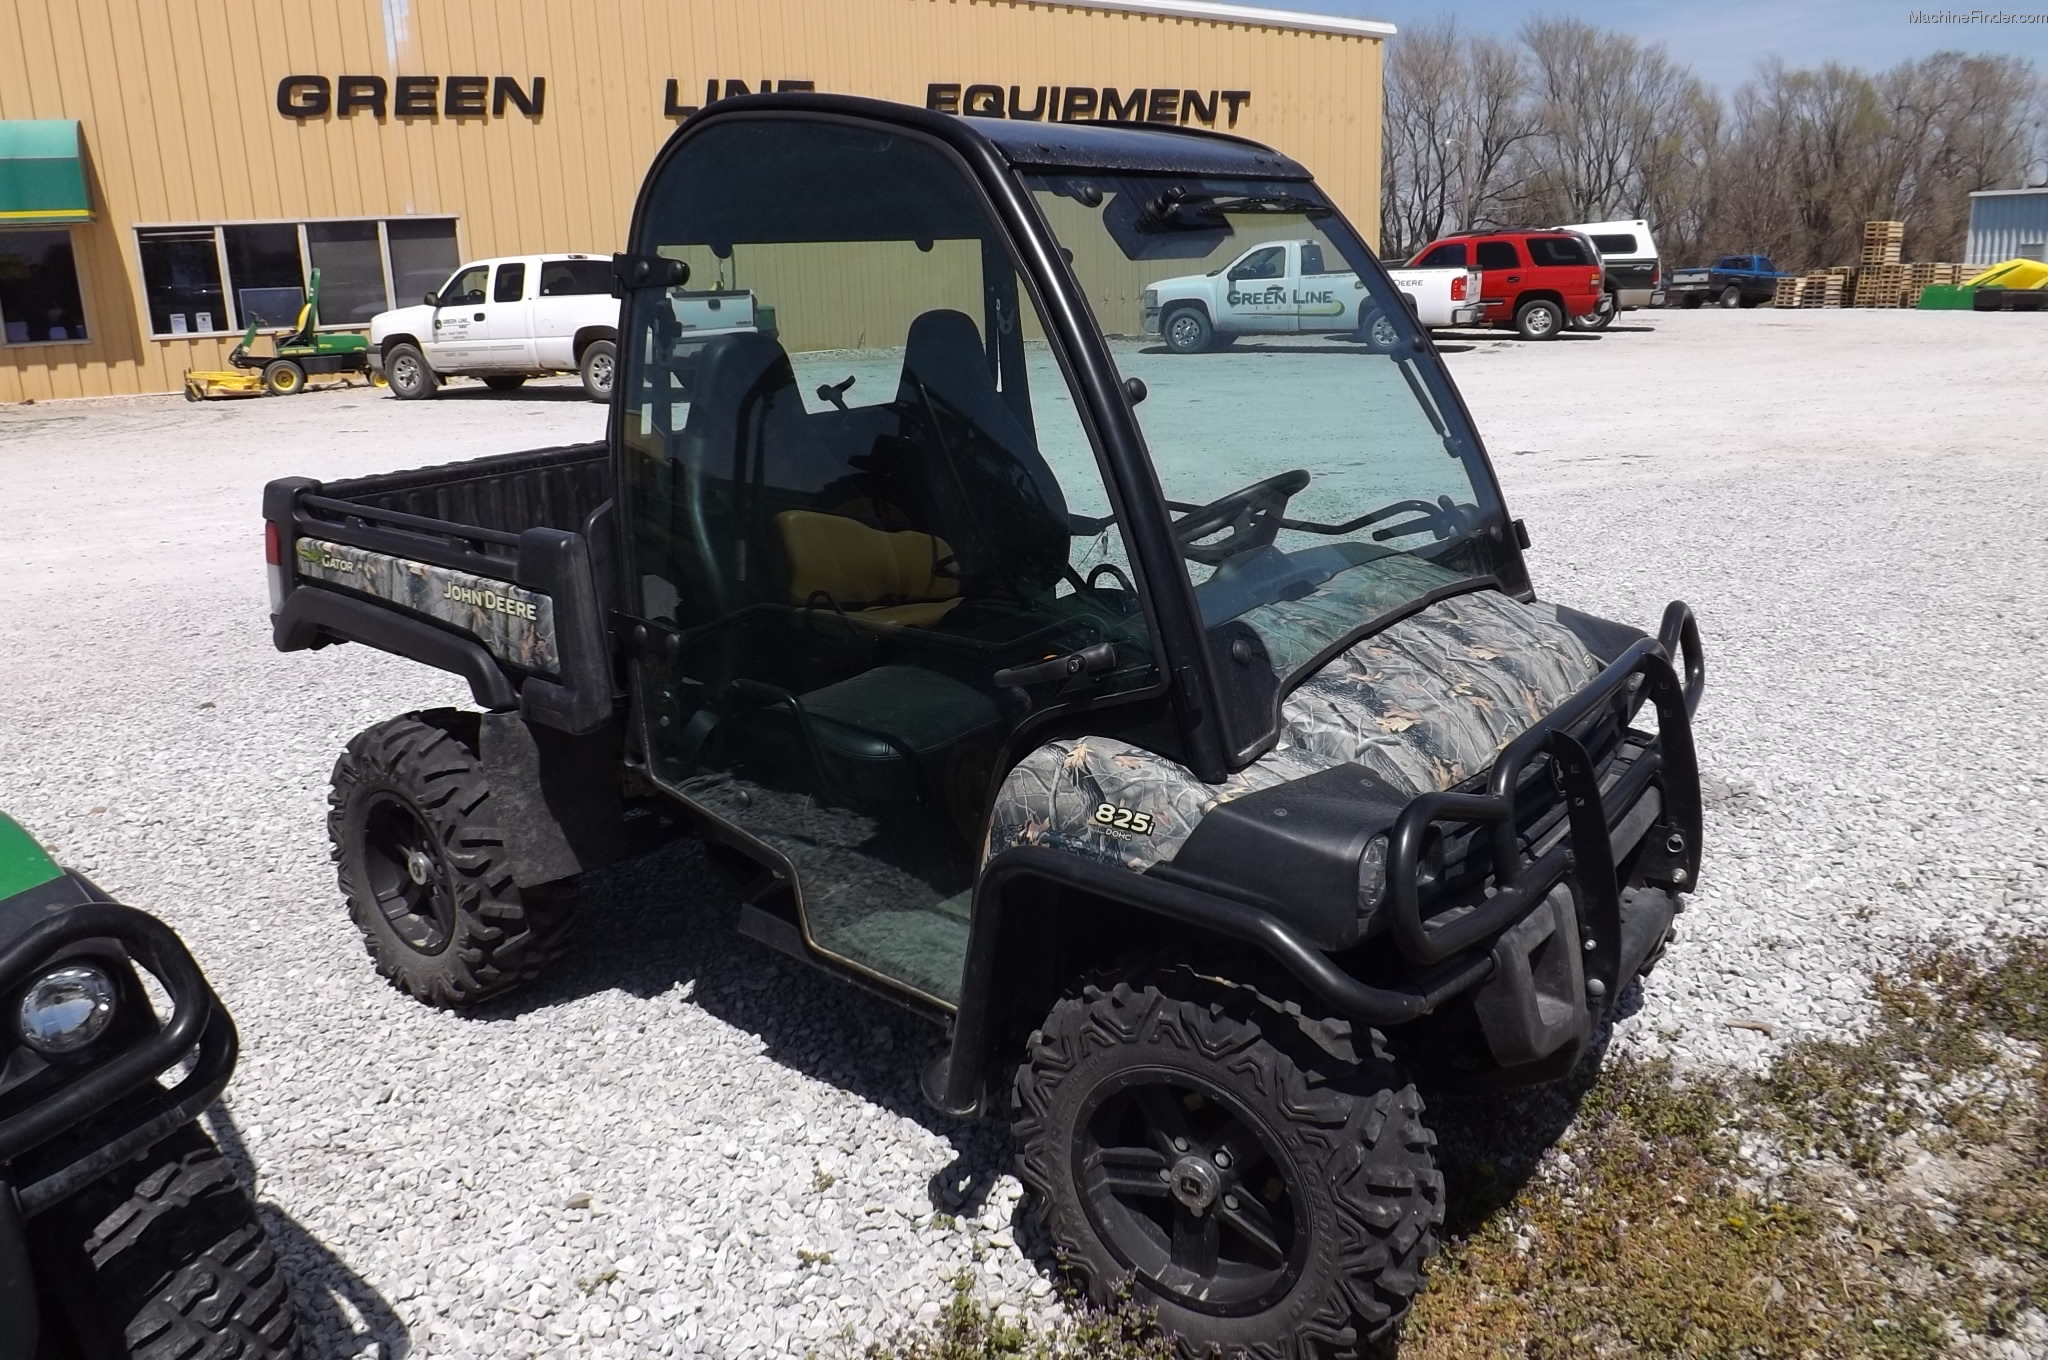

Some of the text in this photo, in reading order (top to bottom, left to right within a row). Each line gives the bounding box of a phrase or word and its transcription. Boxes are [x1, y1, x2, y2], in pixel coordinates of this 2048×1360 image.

[276, 75, 546, 117] GREEN
[926, 83, 1252, 125] EQUIPMENT
[1394, 279, 1424, 287] DEERE
[1227, 289, 1334, 305] GREEN LINE
[321, 554, 354, 572] GATOR
[443, 580, 537, 620] JOHN DEERE
[1094, 802, 1156, 836] 825i
[1105, 828, 1132, 841] DOHC
